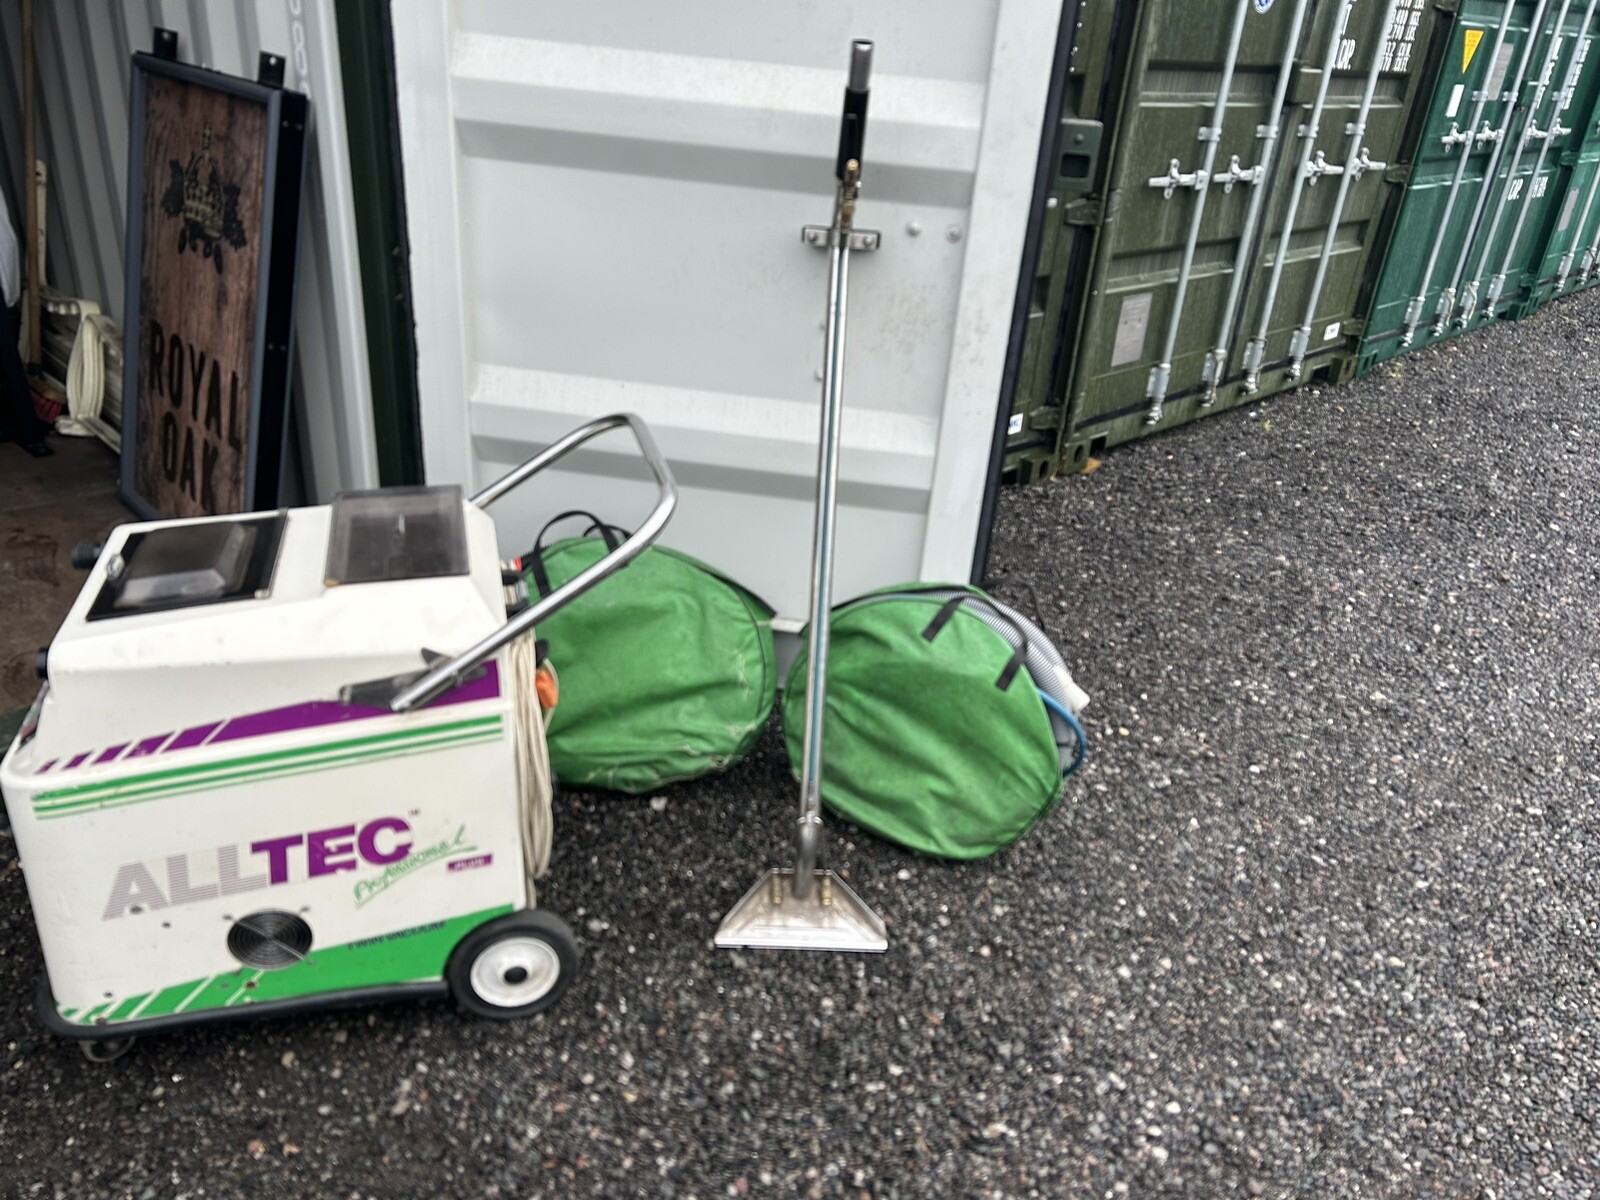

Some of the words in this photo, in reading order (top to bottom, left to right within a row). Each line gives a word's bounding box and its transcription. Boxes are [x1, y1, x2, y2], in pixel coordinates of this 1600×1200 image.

[149, 320, 242, 453] ROYAL
[163, 410, 219, 514] OAK
[101, 816, 414, 921] ALLTEC
